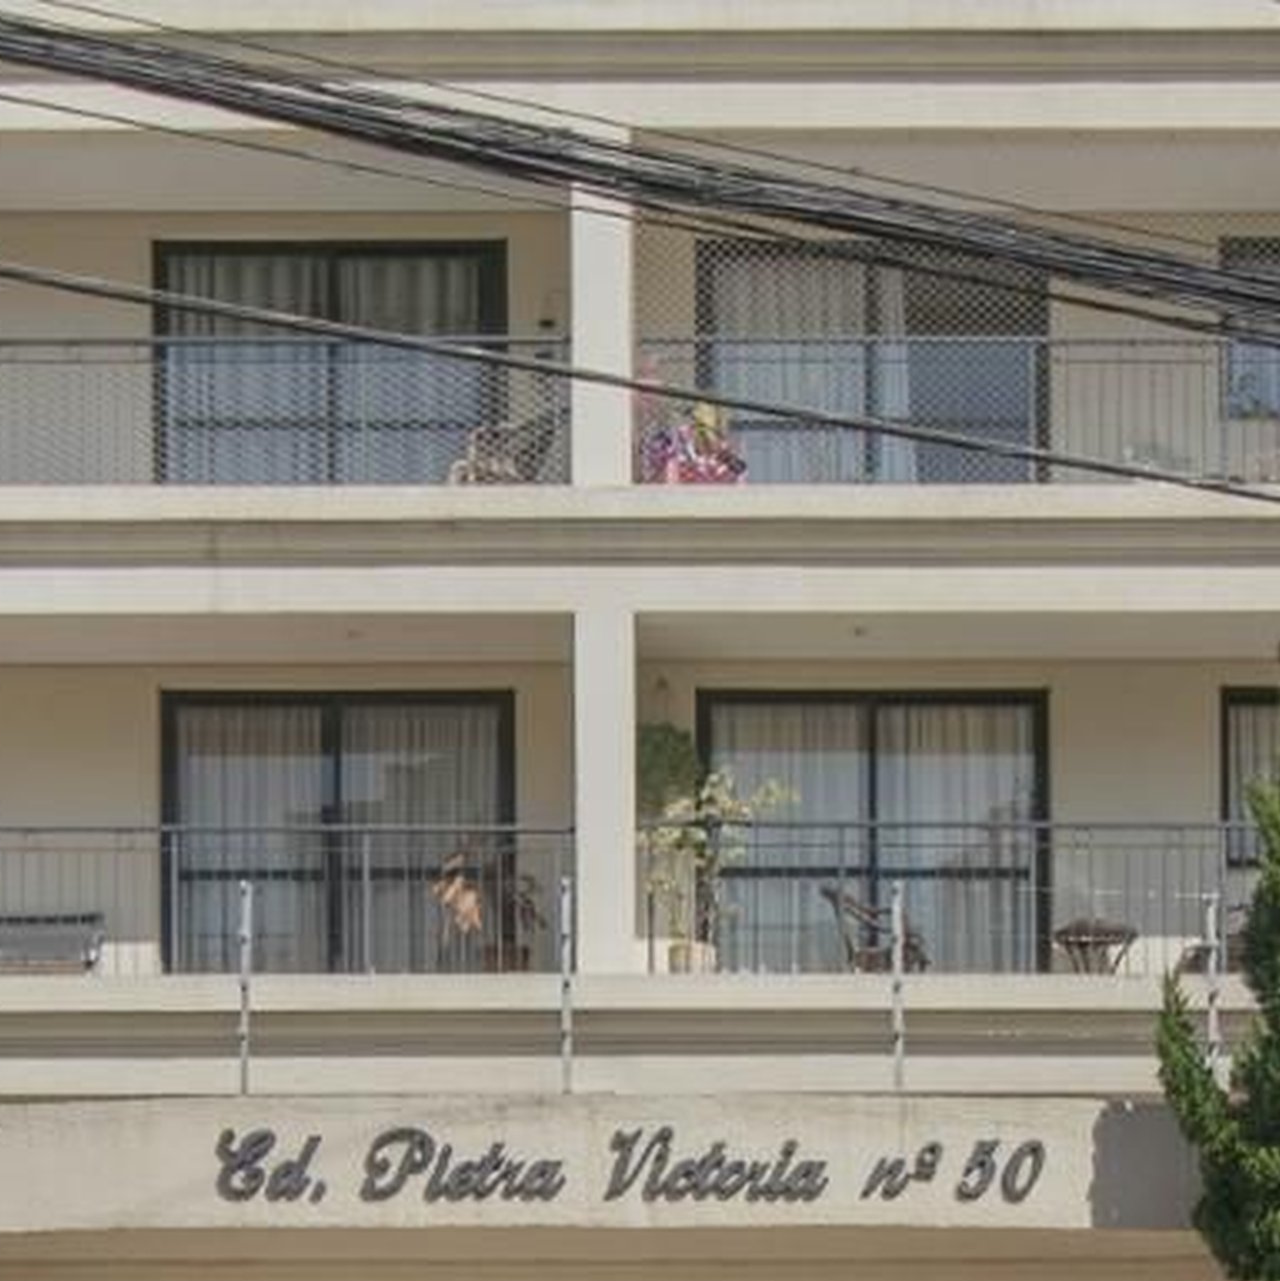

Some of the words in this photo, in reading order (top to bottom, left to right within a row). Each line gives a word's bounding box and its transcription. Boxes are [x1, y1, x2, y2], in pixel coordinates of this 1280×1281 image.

[215, 1128, 327, 1203] Ed.
[359, 1127, 565, 1203] Pietra
[603, 1125, 828, 1202] Victoria
[956, 1139, 1046, 1202] 50
